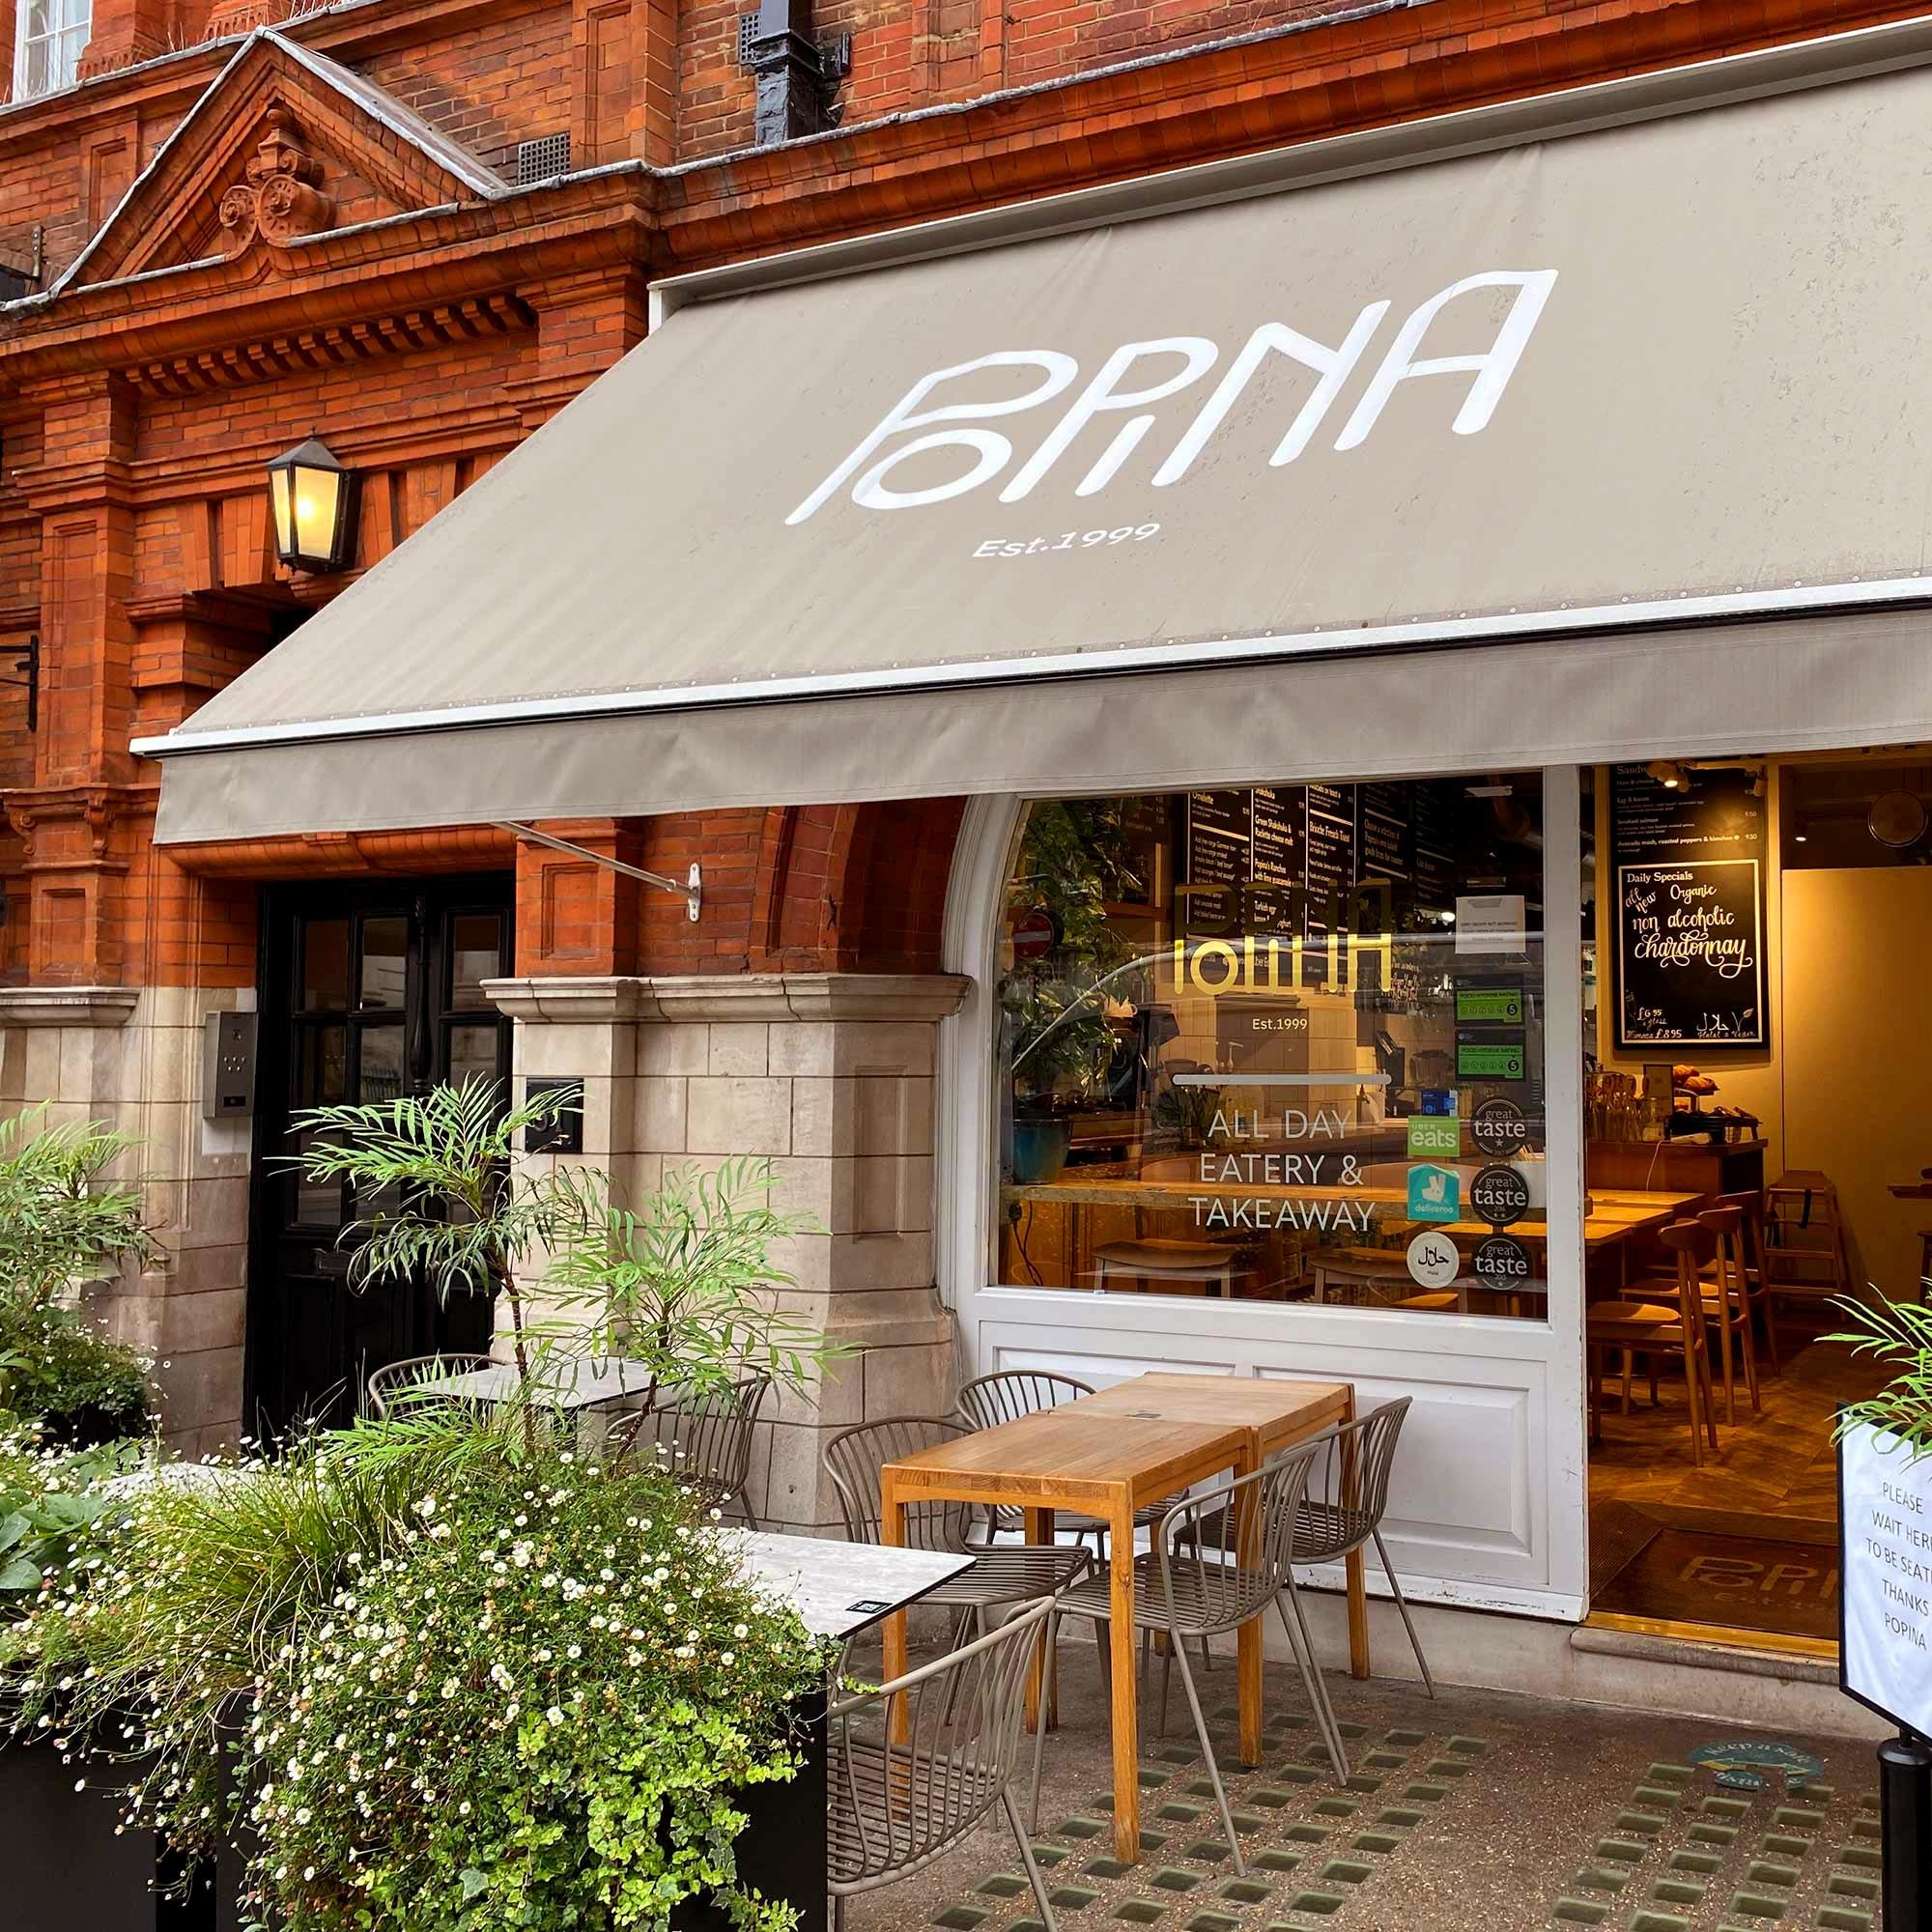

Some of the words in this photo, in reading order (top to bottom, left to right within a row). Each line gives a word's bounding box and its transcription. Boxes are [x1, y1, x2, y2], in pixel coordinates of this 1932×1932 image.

[971, 522, 1162, 559] Est.1999
[1627, 873, 1651, 884] Daily
[1654, 871, 1693, 883] Specials
[1625, 887, 1642, 907] all
[1635, 892, 1657, 914] new
[1670, 884, 1717, 904] Organic
[1633, 916, 1661, 934] non
[1667, 905, 1735, 932] alcoholic
[1509, 1006, 1516, 1014] 5
[1252, 1018, 1308, 1031] Est.1999
[1696, 1012, 1729, 1031] حلال
[1510, 1061, 1518, 1071] 5
[1208, 1109, 1268, 1139] ALL
[1285, 1109, 1352, 1140] DAY
[1486, 1110, 1513, 1121] great
[1411, 1129, 1457, 1148] eats
[1474, 1121, 1525, 1138] taste
[1200, 1153, 1325, 1186] EATERY
[1342, 1155, 1363, 1186] &
[1486, 1178, 1514, 1189] great
[1474, 1188, 1526, 1207] taste
[1188, 1197, 1376, 1233] TAKEAWAY
[1414, 1204, 1454, 1213] deliveroo
[1418, 1246, 1449, 1266] حلال
[1487, 1245, 1515, 1258] great
[1474, 1256, 1527, 1275] taste
[1883, 1482, 1923, 1515] PLEASE
[1871, 1509, 1902, 1537] WAIT
[1865, 1538, 1882, 1558] TO
[1885, 1548, 1897, 1568] BE
[1901, 1556, 1932, 1584] SEAT
[1882, 1578, 1929, 1617] THANKS
[1885, 1612, 1927, 1651] POPINA
[1704, 1742, 1752, 1756] Keep
